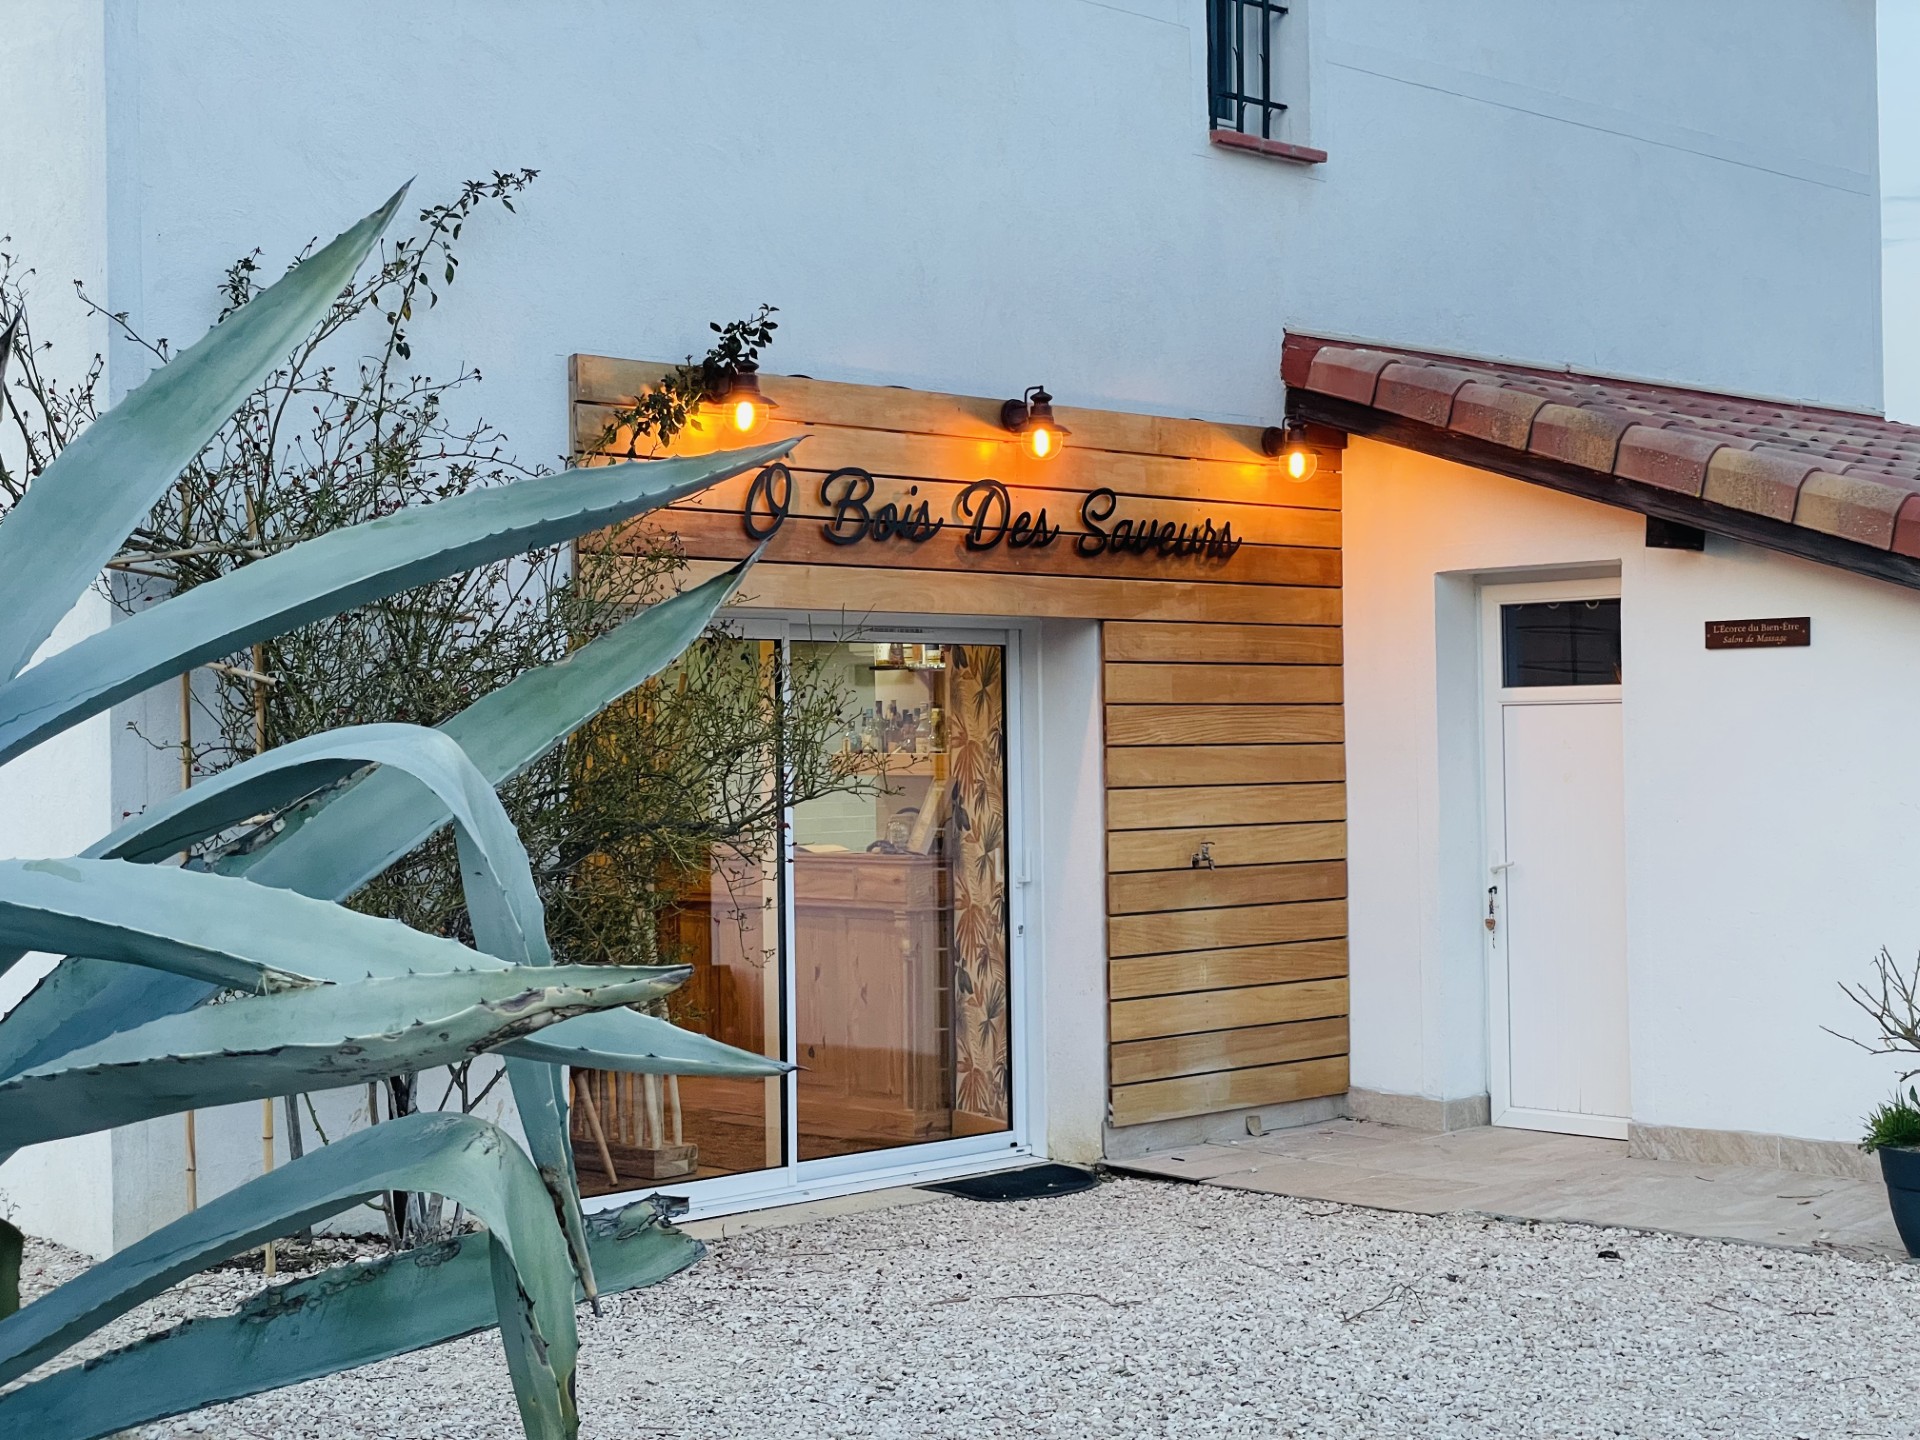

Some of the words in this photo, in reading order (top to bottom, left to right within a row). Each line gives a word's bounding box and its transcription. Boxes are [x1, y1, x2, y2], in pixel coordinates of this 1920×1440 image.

[744, 462, 792, 540] O
[821, 467, 944, 545] Bois
[962, 479, 1060, 550] Des
[1077, 487, 1243, 557] Saveurs
[1748, 623, 1759, 632] du
[1722, 635, 1743, 644] Salon
[1745, 635, 1754, 643] de
[1756, 634, 1788, 645] Massage
